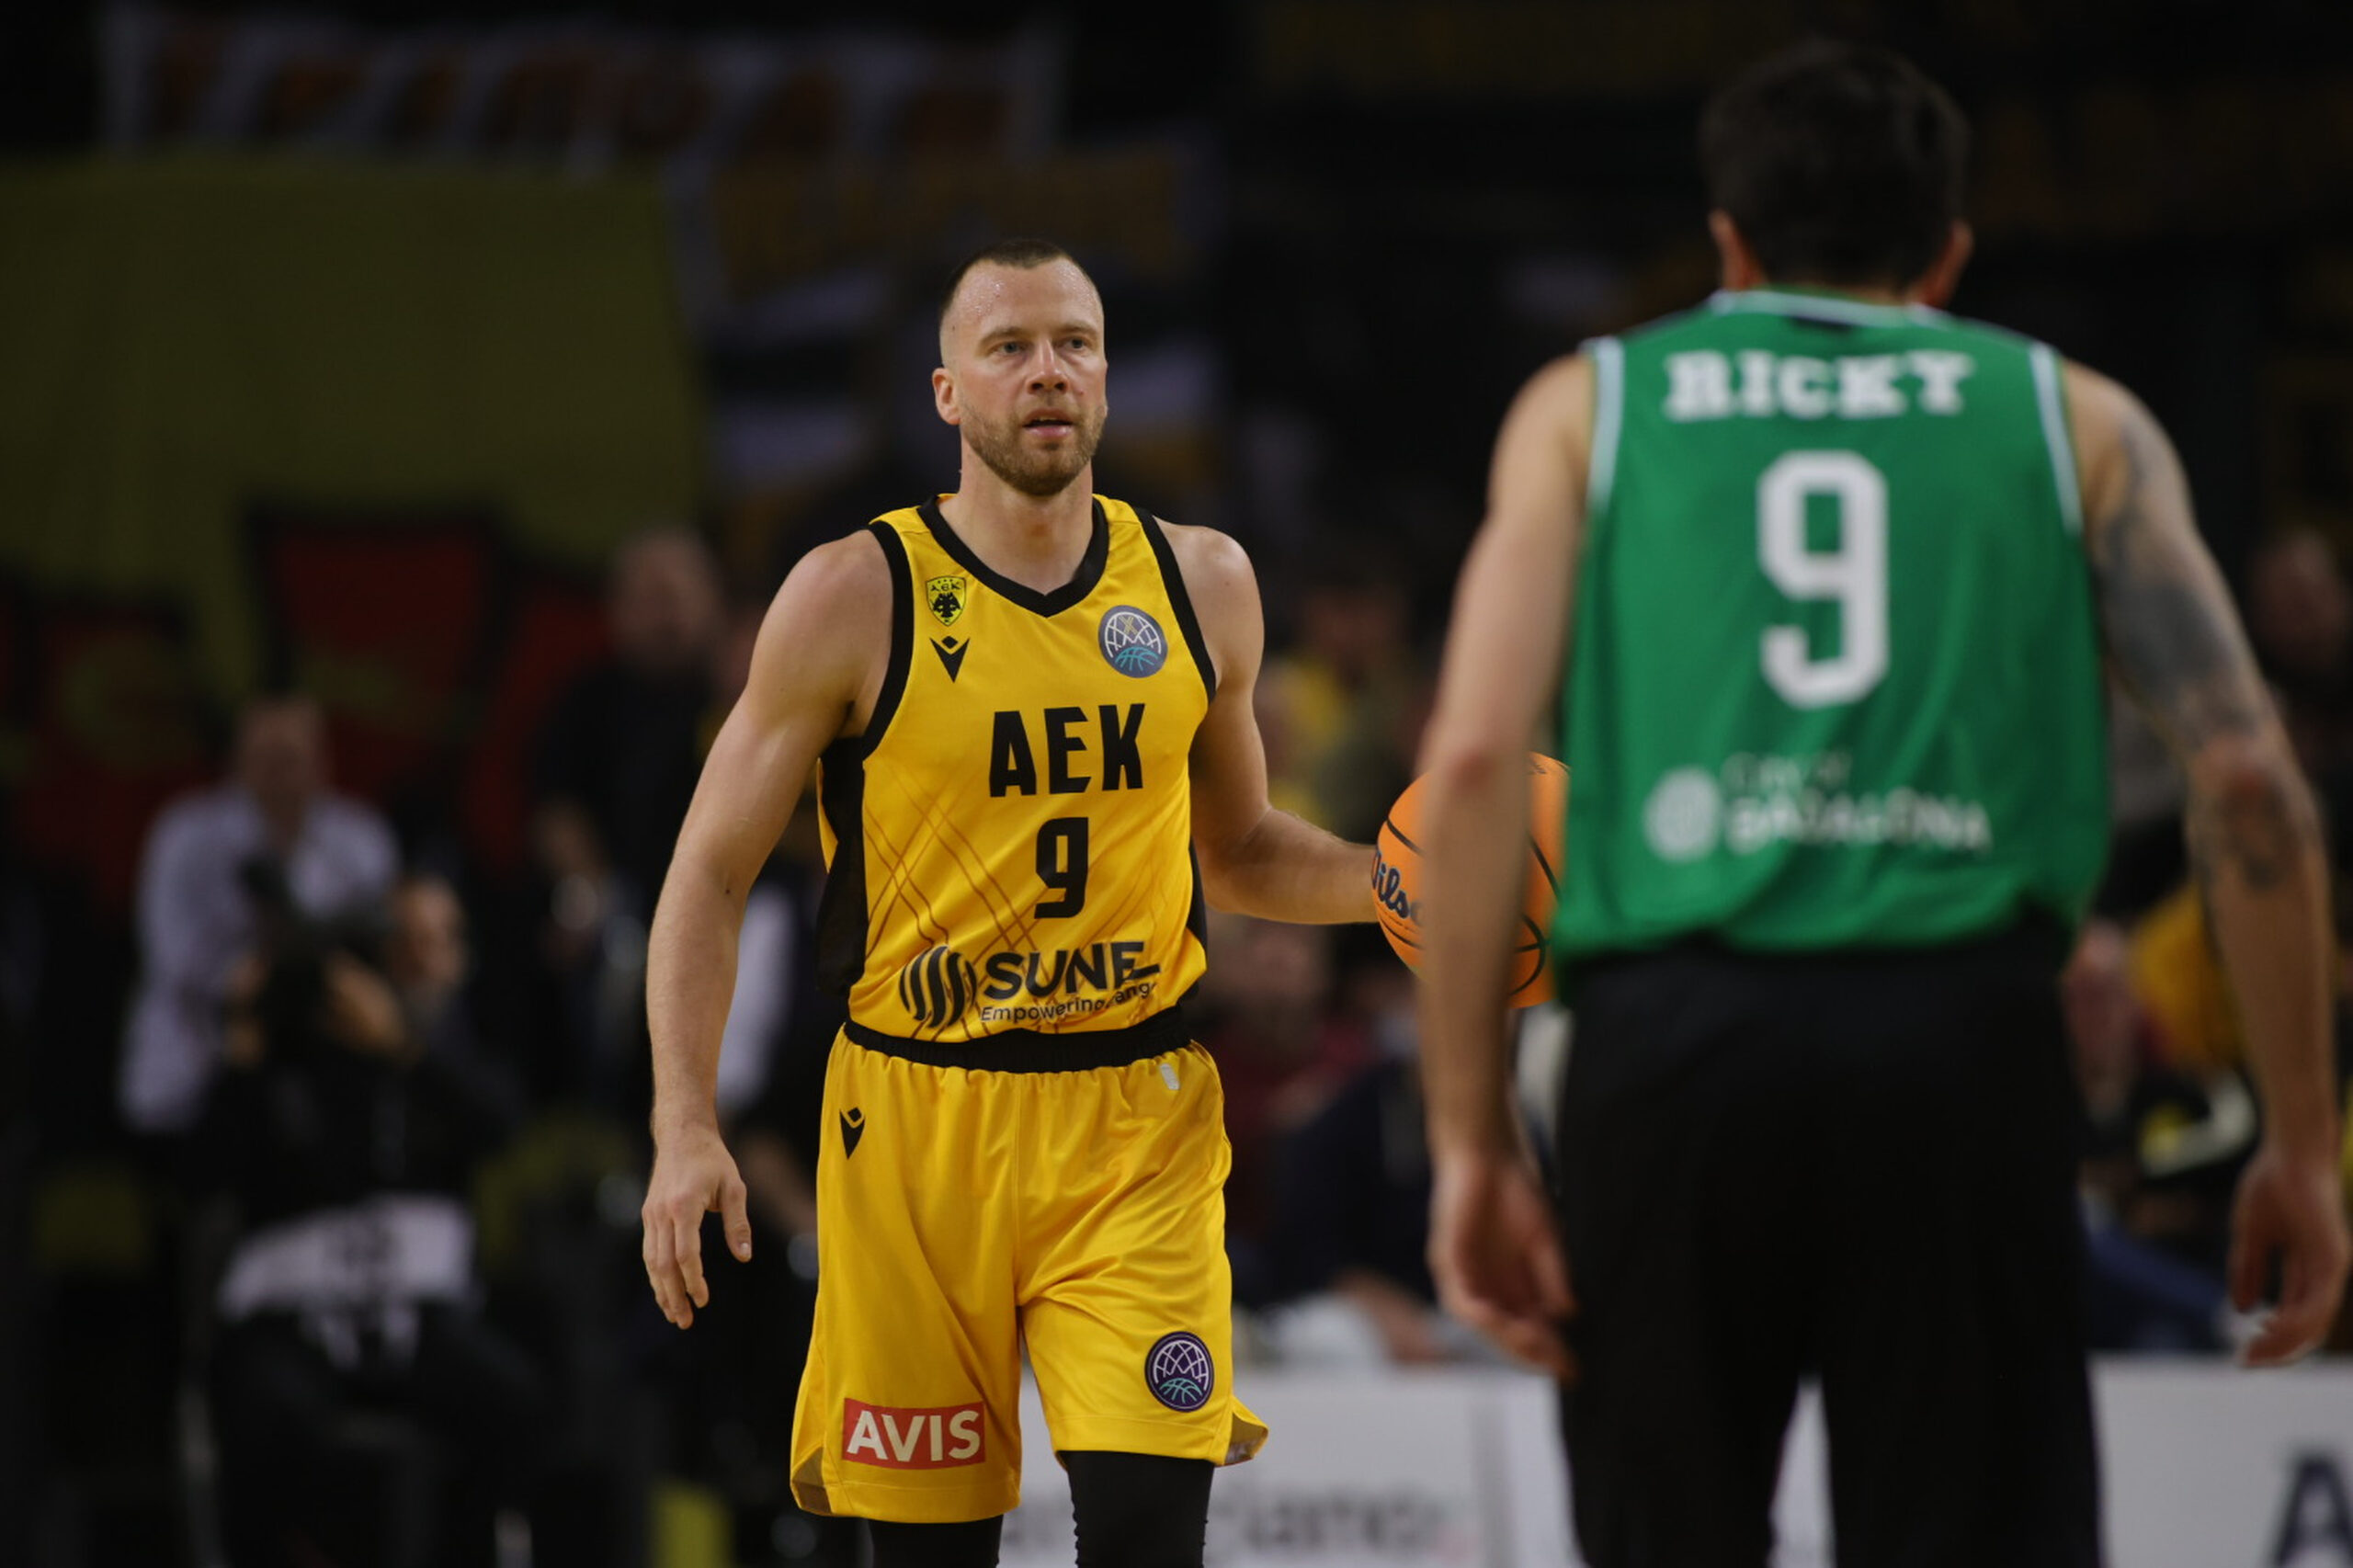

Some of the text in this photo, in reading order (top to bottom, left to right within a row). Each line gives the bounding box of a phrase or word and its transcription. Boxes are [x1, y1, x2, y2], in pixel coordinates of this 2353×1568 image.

[1665, 349, 1976, 422] RICKY
[1756, 450, 1889, 709] 9
[989, 703, 1145, 797] AEK
[1034, 817, 1089, 918] 9
[847, 1410, 981, 1462] AVIS
